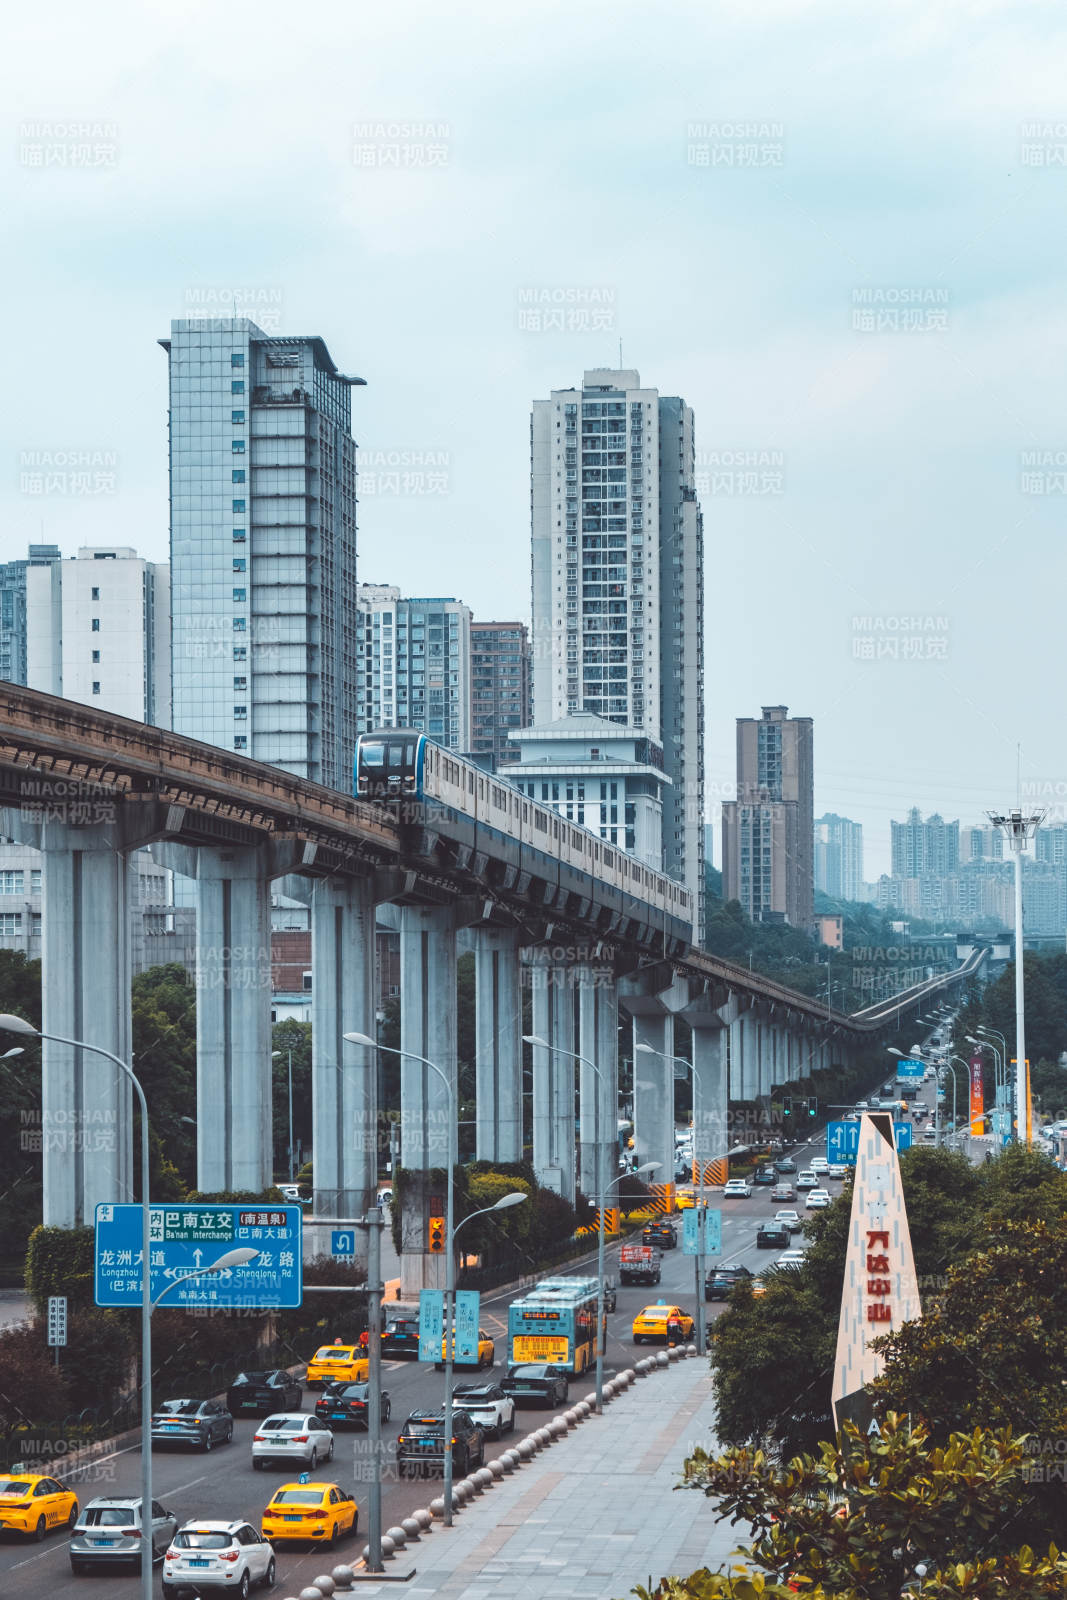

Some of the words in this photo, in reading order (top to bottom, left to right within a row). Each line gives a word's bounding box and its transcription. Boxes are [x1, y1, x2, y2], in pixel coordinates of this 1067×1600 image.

[101, 1206, 109, 1215] 北
[166, 1212, 232, 1228] 巴南立交
[240, 1213, 285, 1225] (南温泉)
[150, 1212, 162, 1239] 内环
[234, 1228, 292, 1240] (巴南大道)
[102, 1268, 138, 1278] Longzhou
